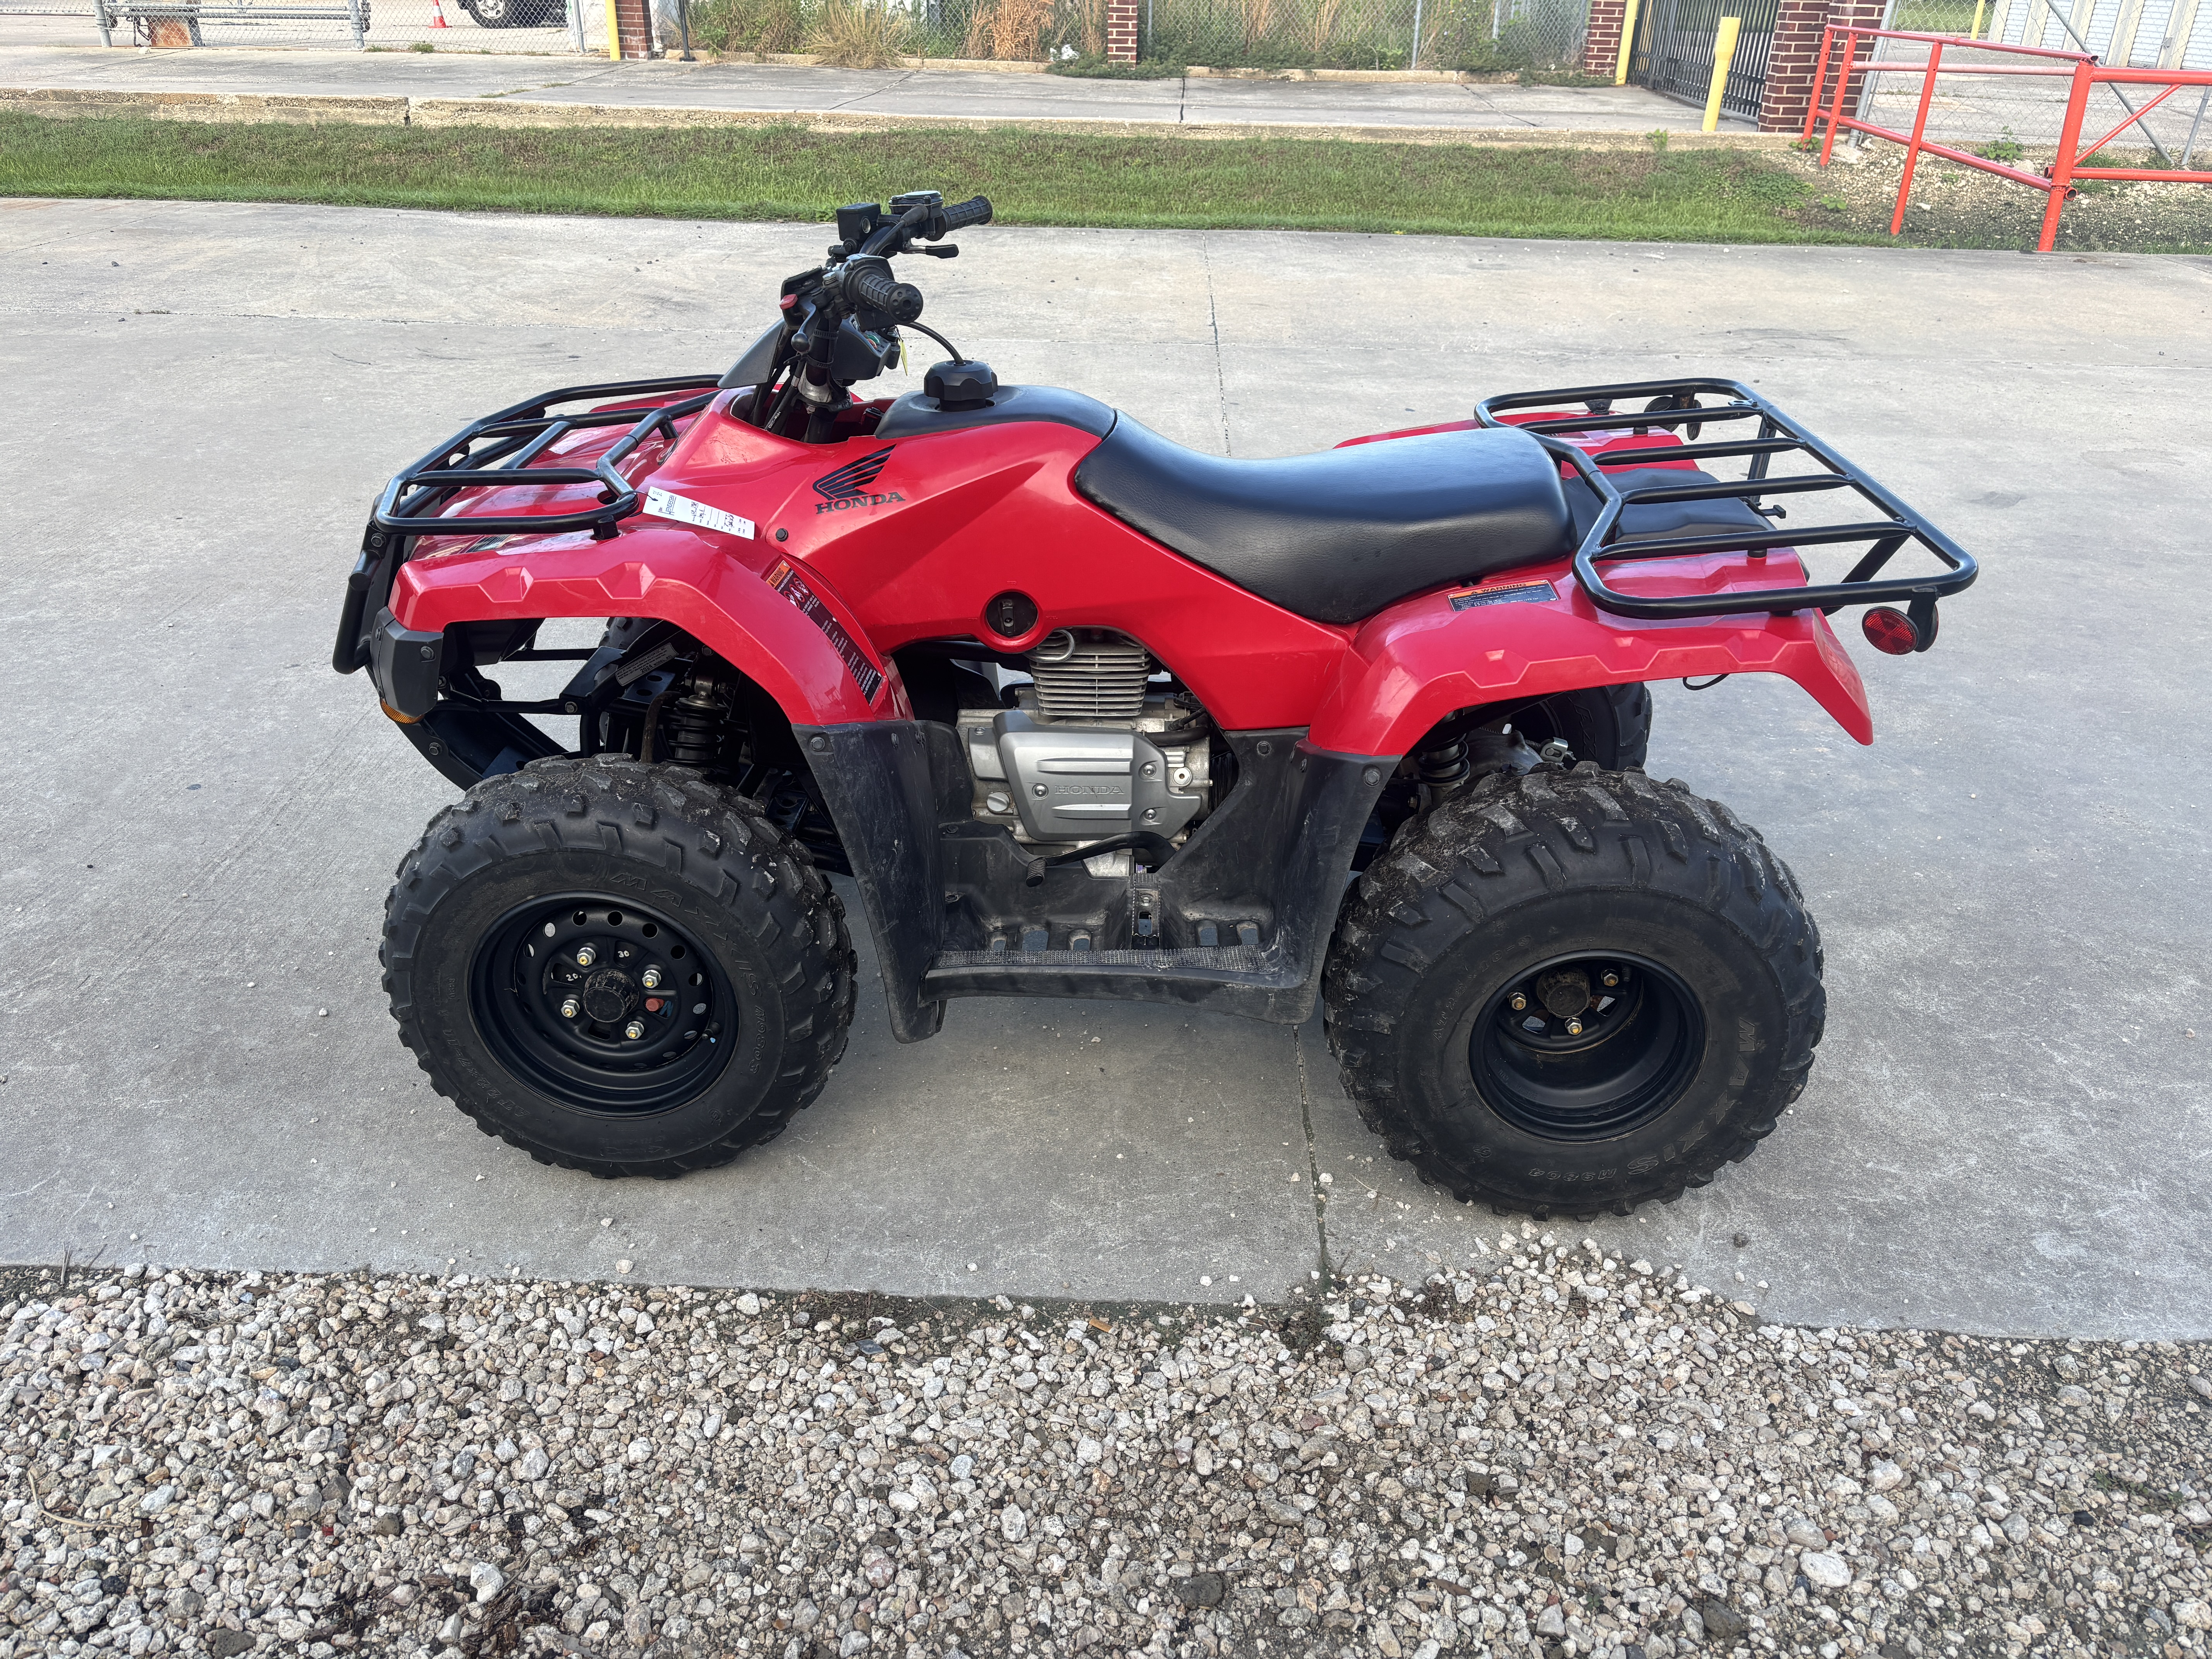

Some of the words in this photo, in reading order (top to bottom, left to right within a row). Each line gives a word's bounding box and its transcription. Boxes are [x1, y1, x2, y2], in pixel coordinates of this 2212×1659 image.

[815, 492, 906, 514] HONDA
[770, 568, 784, 584] WARNING
[1481, 583, 1527, 592] WARNING
[640, 664, 653, 673] 2024
[1054, 785, 1125, 794] HONDA
[610, 873, 762, 996] MAXXIS
[1627, 1017, 1756, 1175] MAXXIS
[1528, 1168, 1617, 1181] M9804
